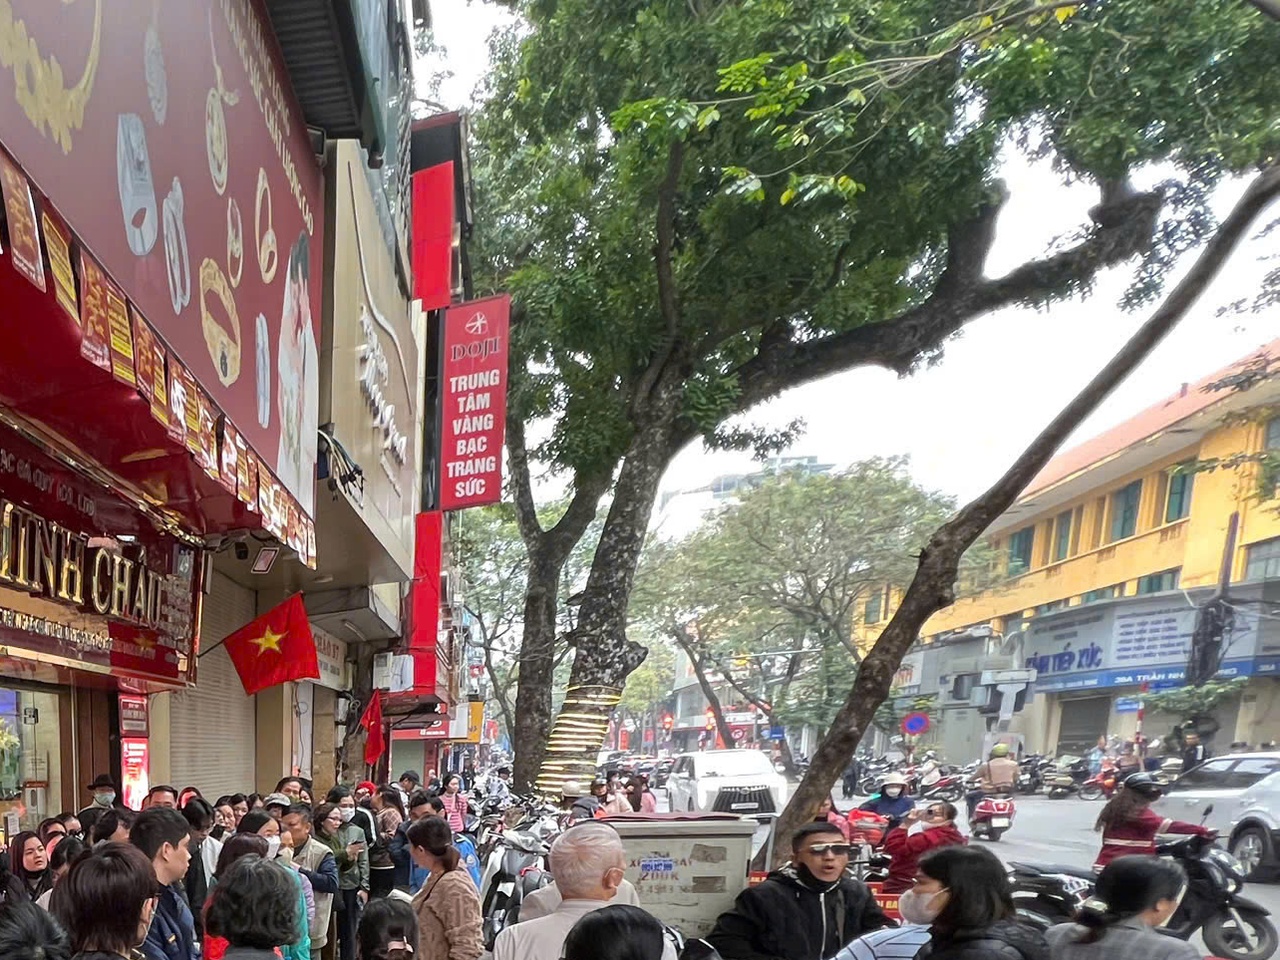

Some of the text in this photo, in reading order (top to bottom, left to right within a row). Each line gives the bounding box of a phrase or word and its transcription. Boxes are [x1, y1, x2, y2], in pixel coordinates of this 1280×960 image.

[451, 335, 501, 362] DOJI
[450, 369, 500, 393] TRUNG
[457, 391, 490, 414] TÂM
[452, 413, 494, 436] VÀNG
[456, 435, 488, 459] BẠC
[447, 456, 496, 479] TRANG
[455, 477, 486, 498] SỨC
[91, 546, 164, 631] CHÂU
[1077, 641, 1103, 669] XÚC
